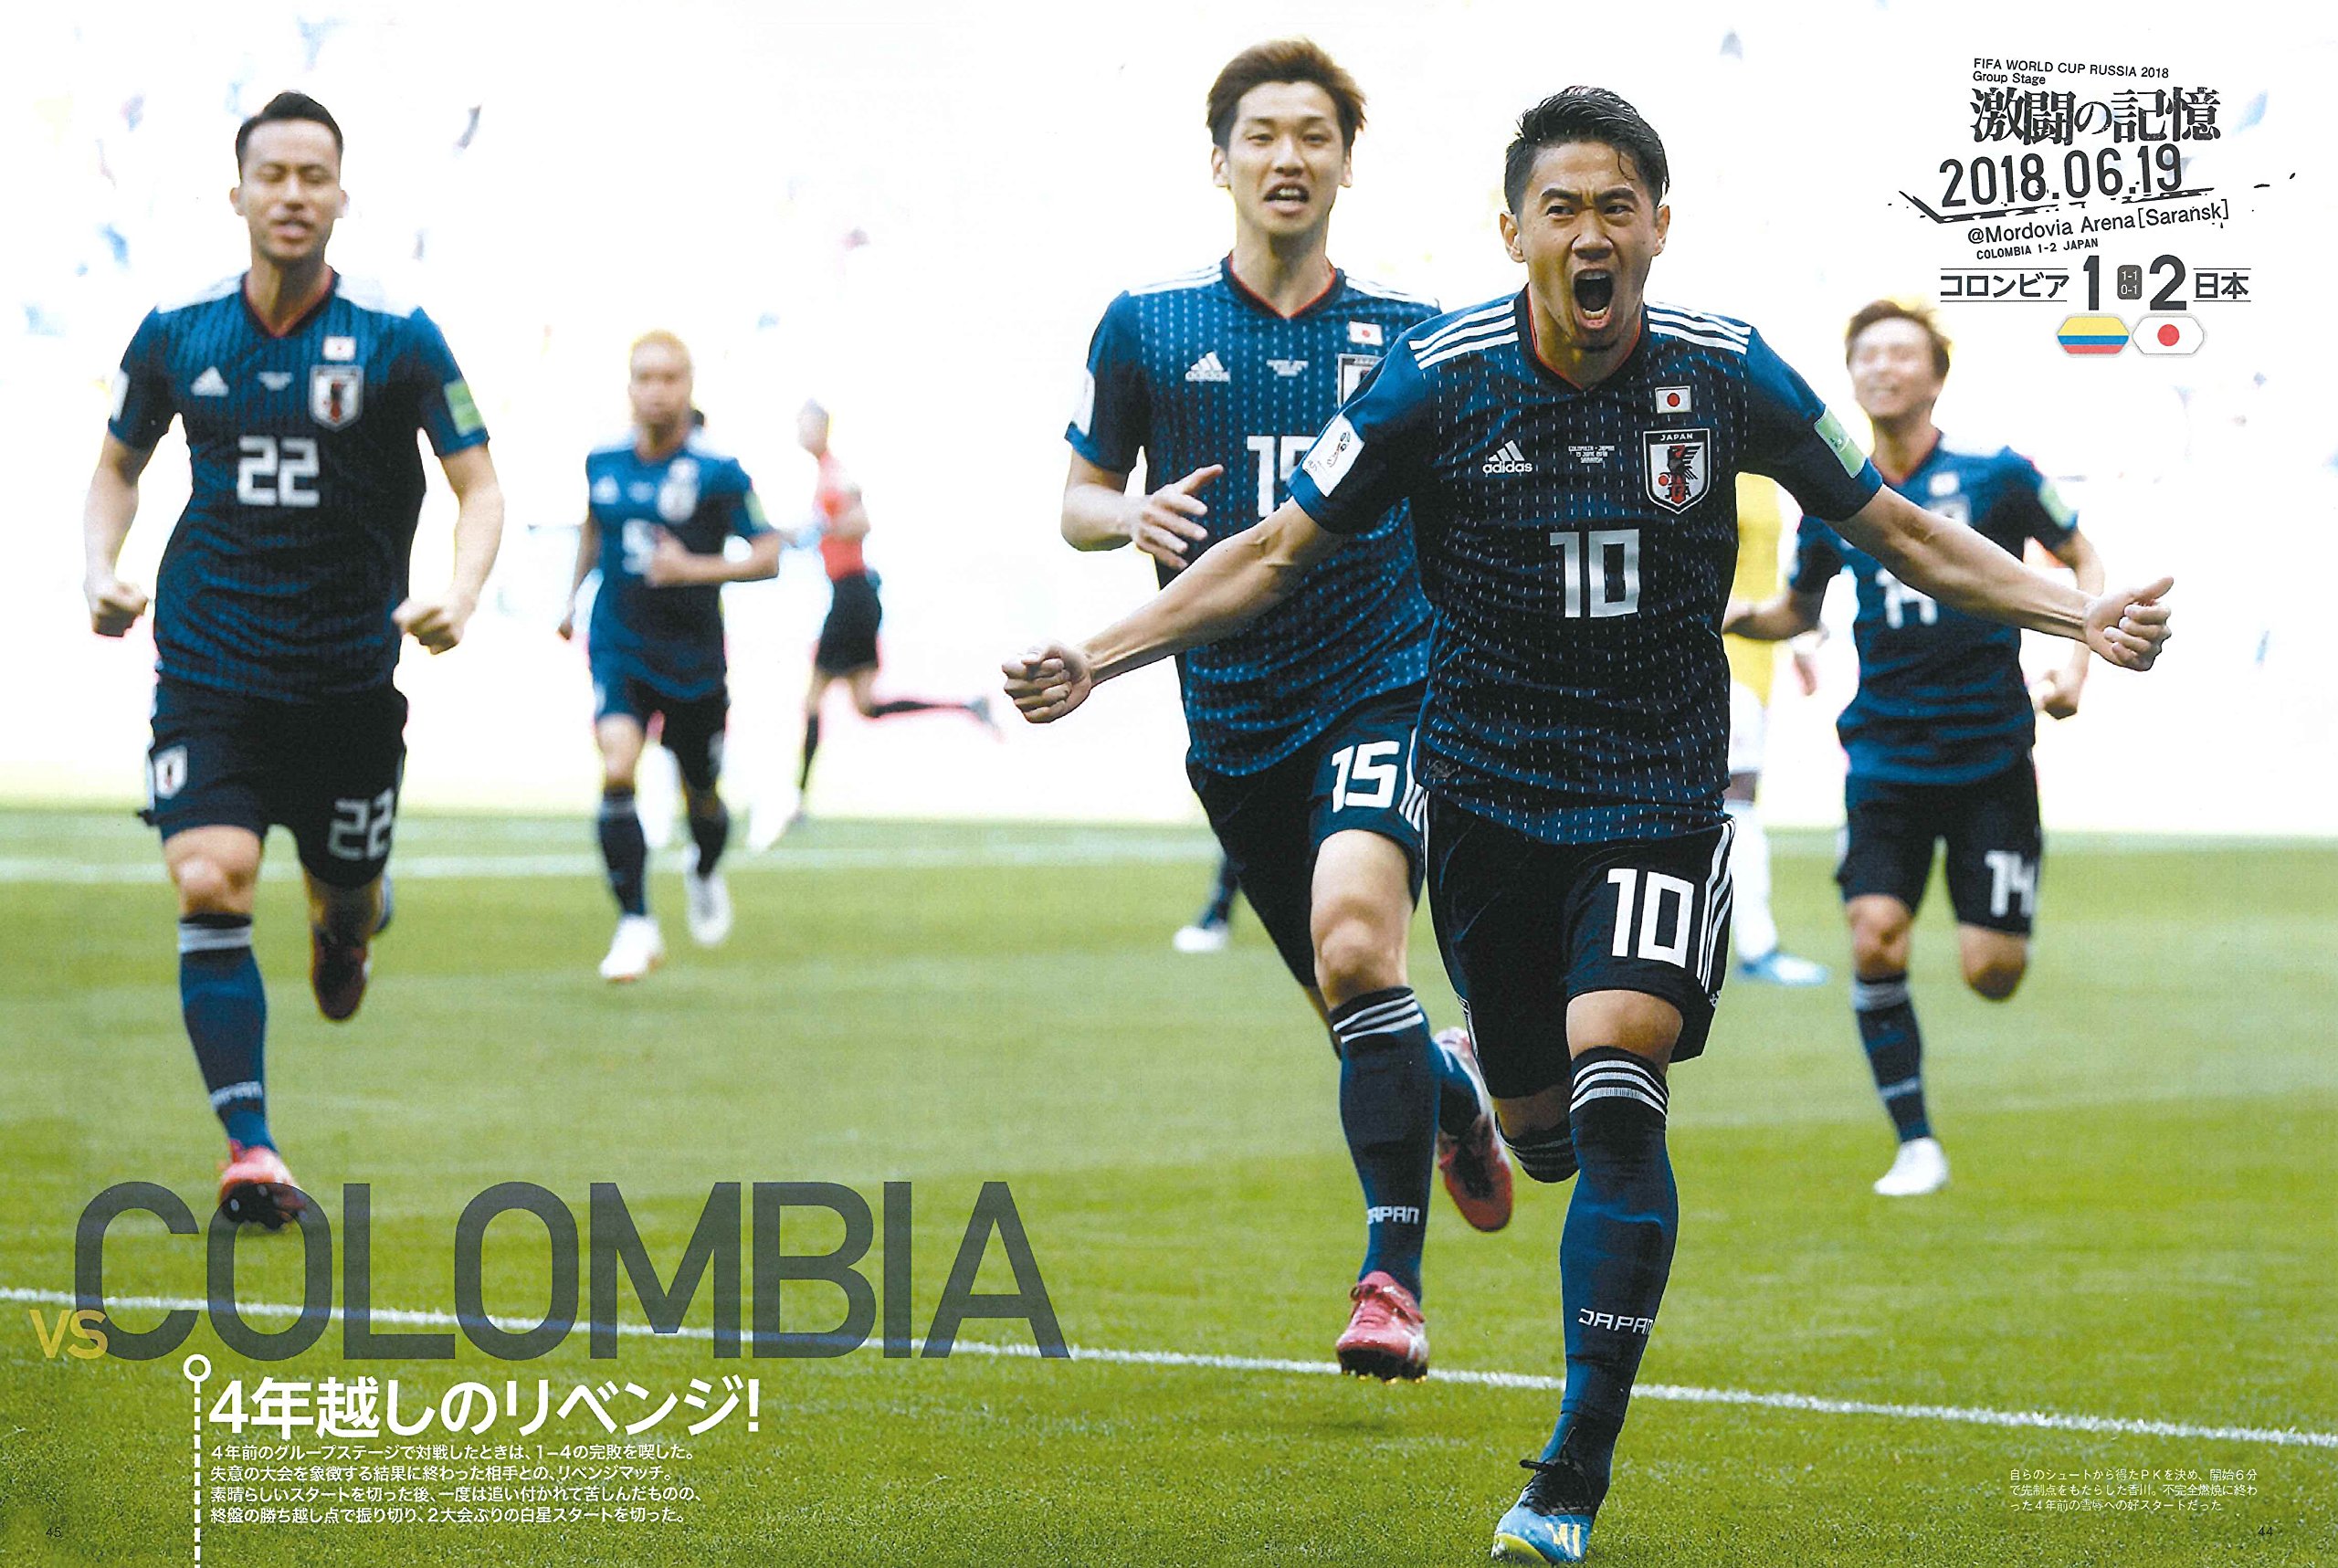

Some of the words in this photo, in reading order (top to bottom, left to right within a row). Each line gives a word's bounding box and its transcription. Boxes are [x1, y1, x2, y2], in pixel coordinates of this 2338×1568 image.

[237, 435, 321, 508] 22
[1482, 461, 1532, 473] adidas
[1660, 433, 1693, 441] JAPAN
[1550, 529, 1641, 618] 10
[1332, 741, 1400, 813] 15
[327, 787, 396, 861] 22
[1607, 868, 1695, 969] 10
[1985, 850, 2037, 917] 14
